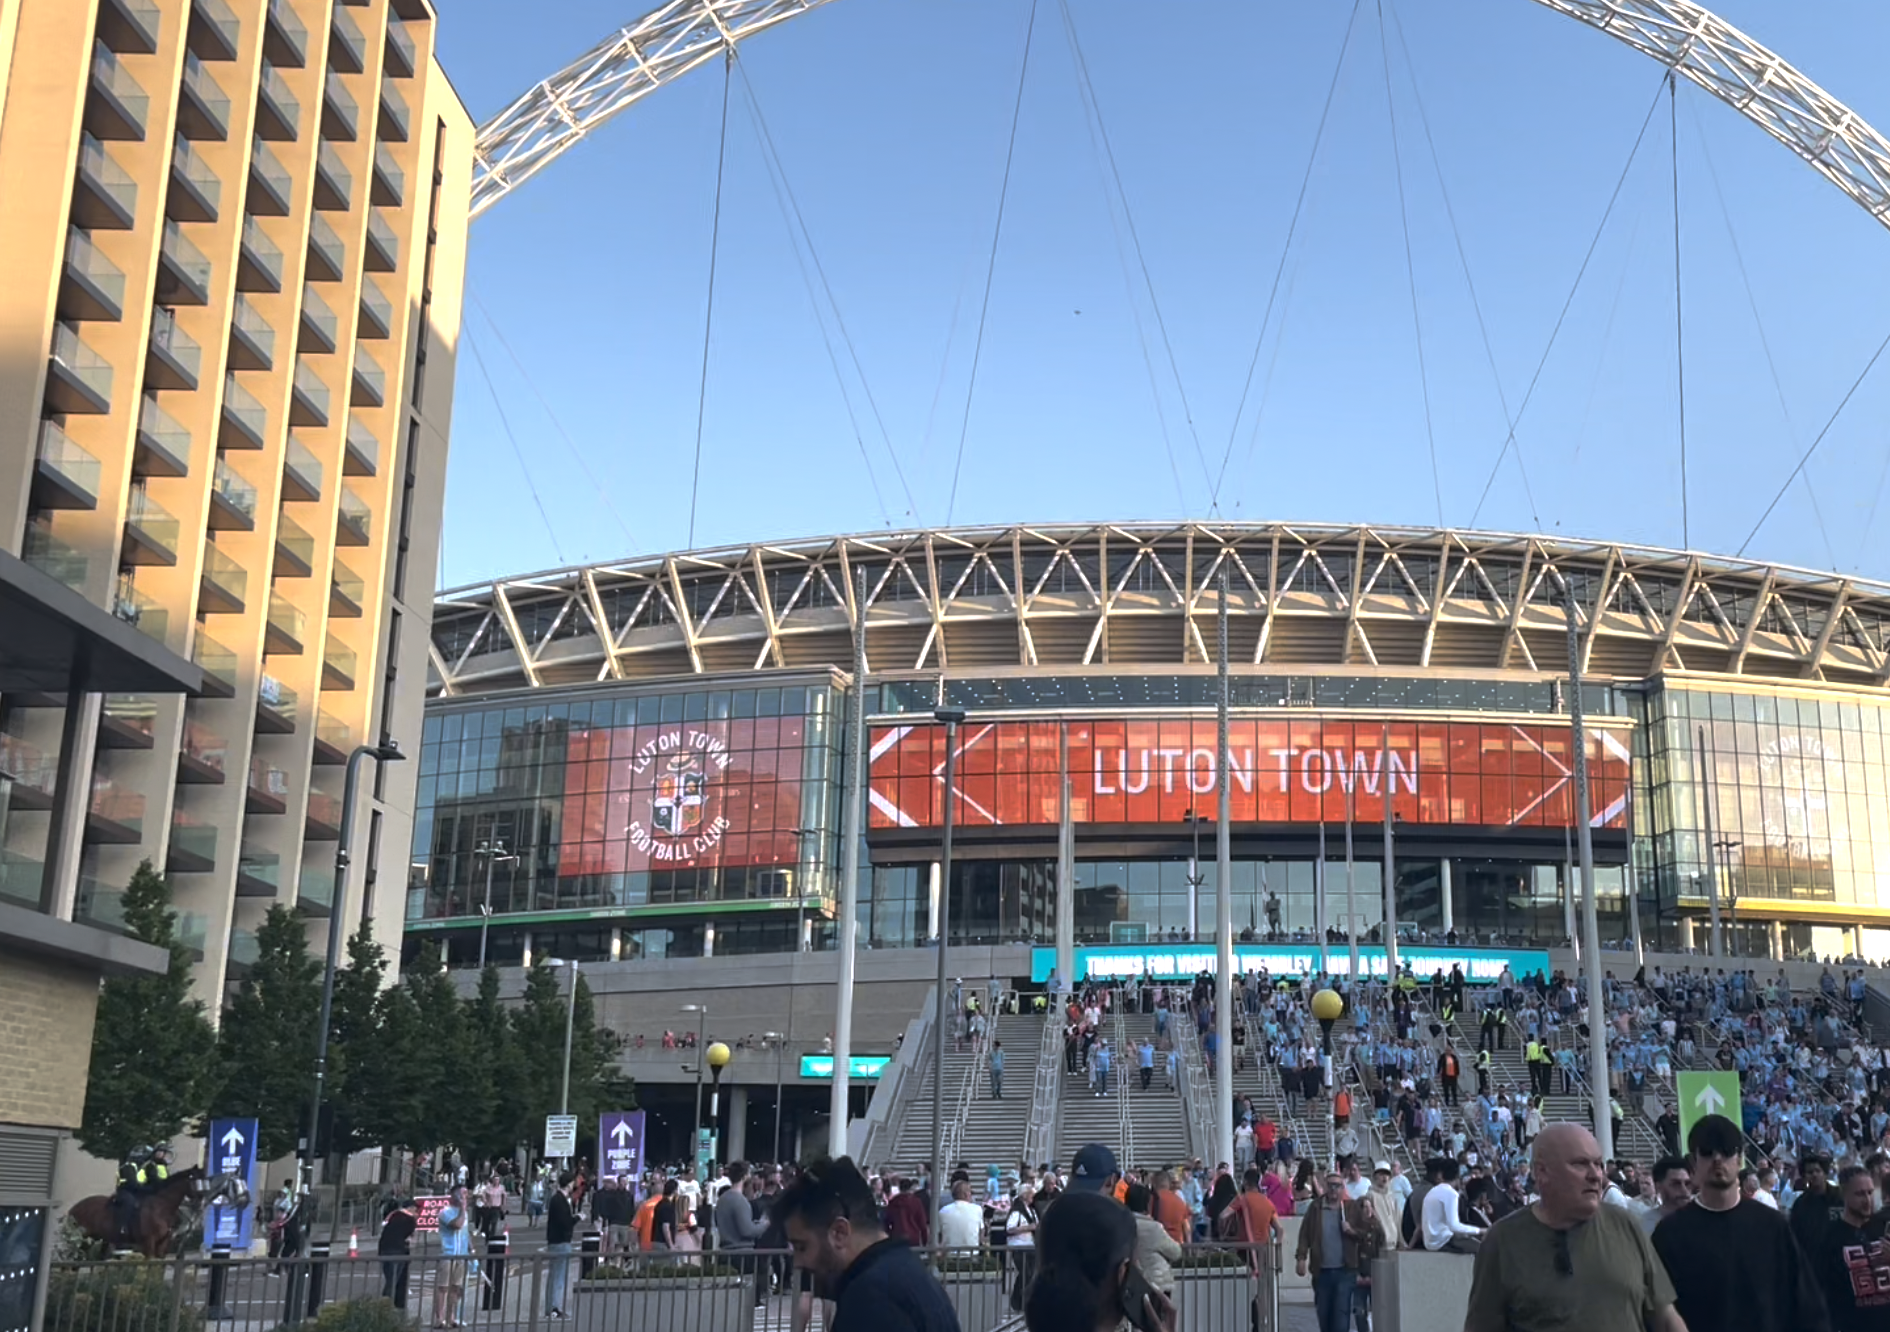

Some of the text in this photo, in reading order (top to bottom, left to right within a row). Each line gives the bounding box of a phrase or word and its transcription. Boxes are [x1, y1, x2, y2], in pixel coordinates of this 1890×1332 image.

[628, 730, 734, 775] LUTON TOWN
[1094, 748, 1417, 795] LUTON TOWN
[624, 815, 730, 861] FOOTBALL CLUB
[1086, 955, 1144, 975] THANKS
[1146, 955, 1175, 975] FOR
[1358, 955, 1369, 975] A
[423, 1200, 450, 1208] ROAD
